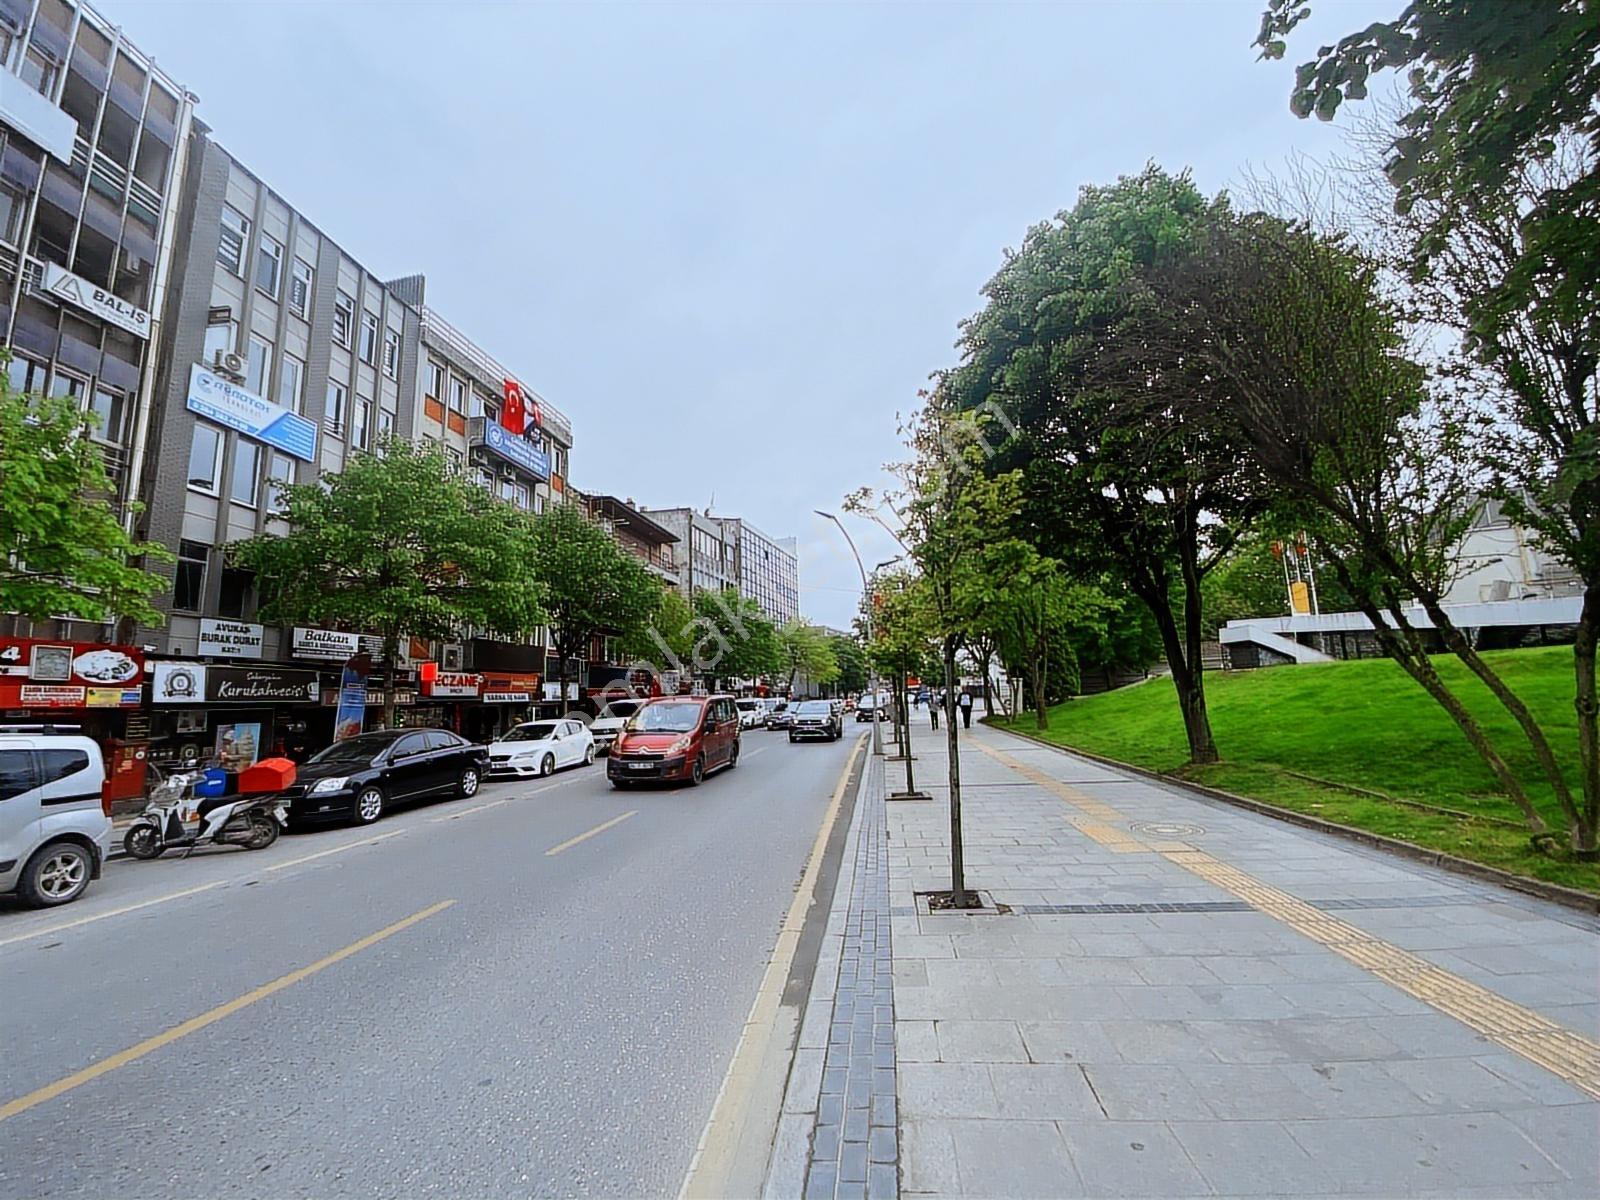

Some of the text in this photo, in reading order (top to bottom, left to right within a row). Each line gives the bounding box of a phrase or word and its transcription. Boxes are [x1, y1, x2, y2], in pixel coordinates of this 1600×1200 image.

[201, 632, 231, 644] BURAK
[304, 629, 350, 644] Balkan
[435, 674, 479, 687] ECZANE
[217, 680, 305, 698] Kurukahvecisi
